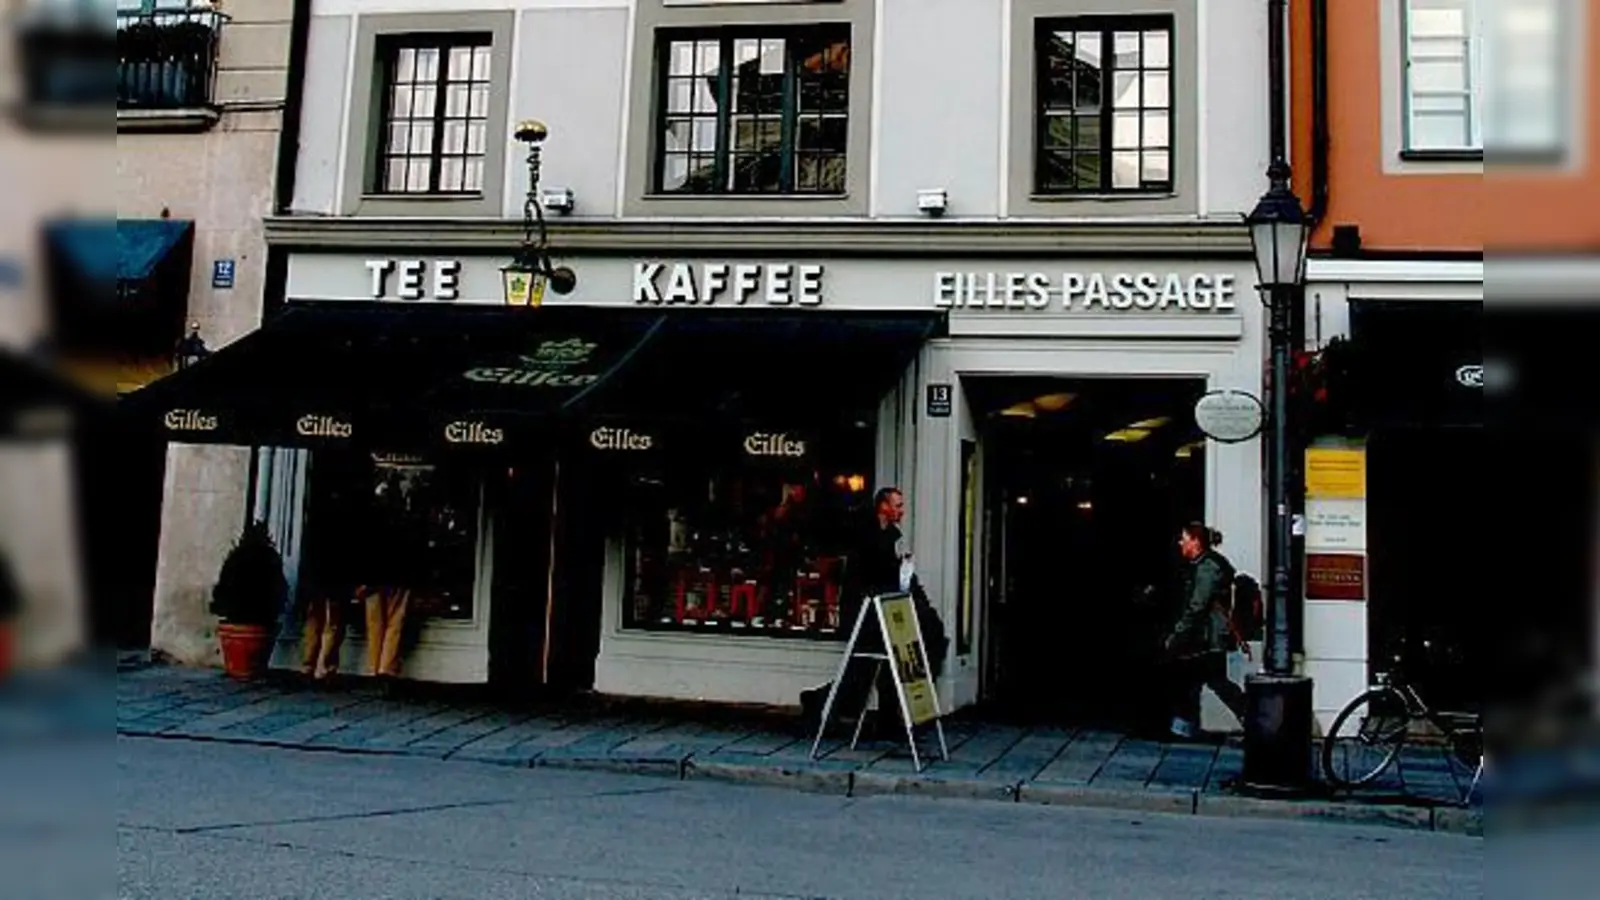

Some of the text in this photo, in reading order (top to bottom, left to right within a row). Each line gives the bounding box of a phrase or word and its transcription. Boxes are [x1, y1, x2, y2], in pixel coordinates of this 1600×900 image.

[365, 260, 461, 300] TEE
[633, 262, 823, 304] KAFFEE
[934, 271, 1236, 311] EILLES PASSAGE
[933, 387, 948, 401] 13
[164, 408, 218, 431] Eilles
[296, 414, 352, 437] Eilles
[445, 420, 504, 445] Eilles
[590, 426, 652, 450] Eilles
[743, 432, 806, 457] Eilles
